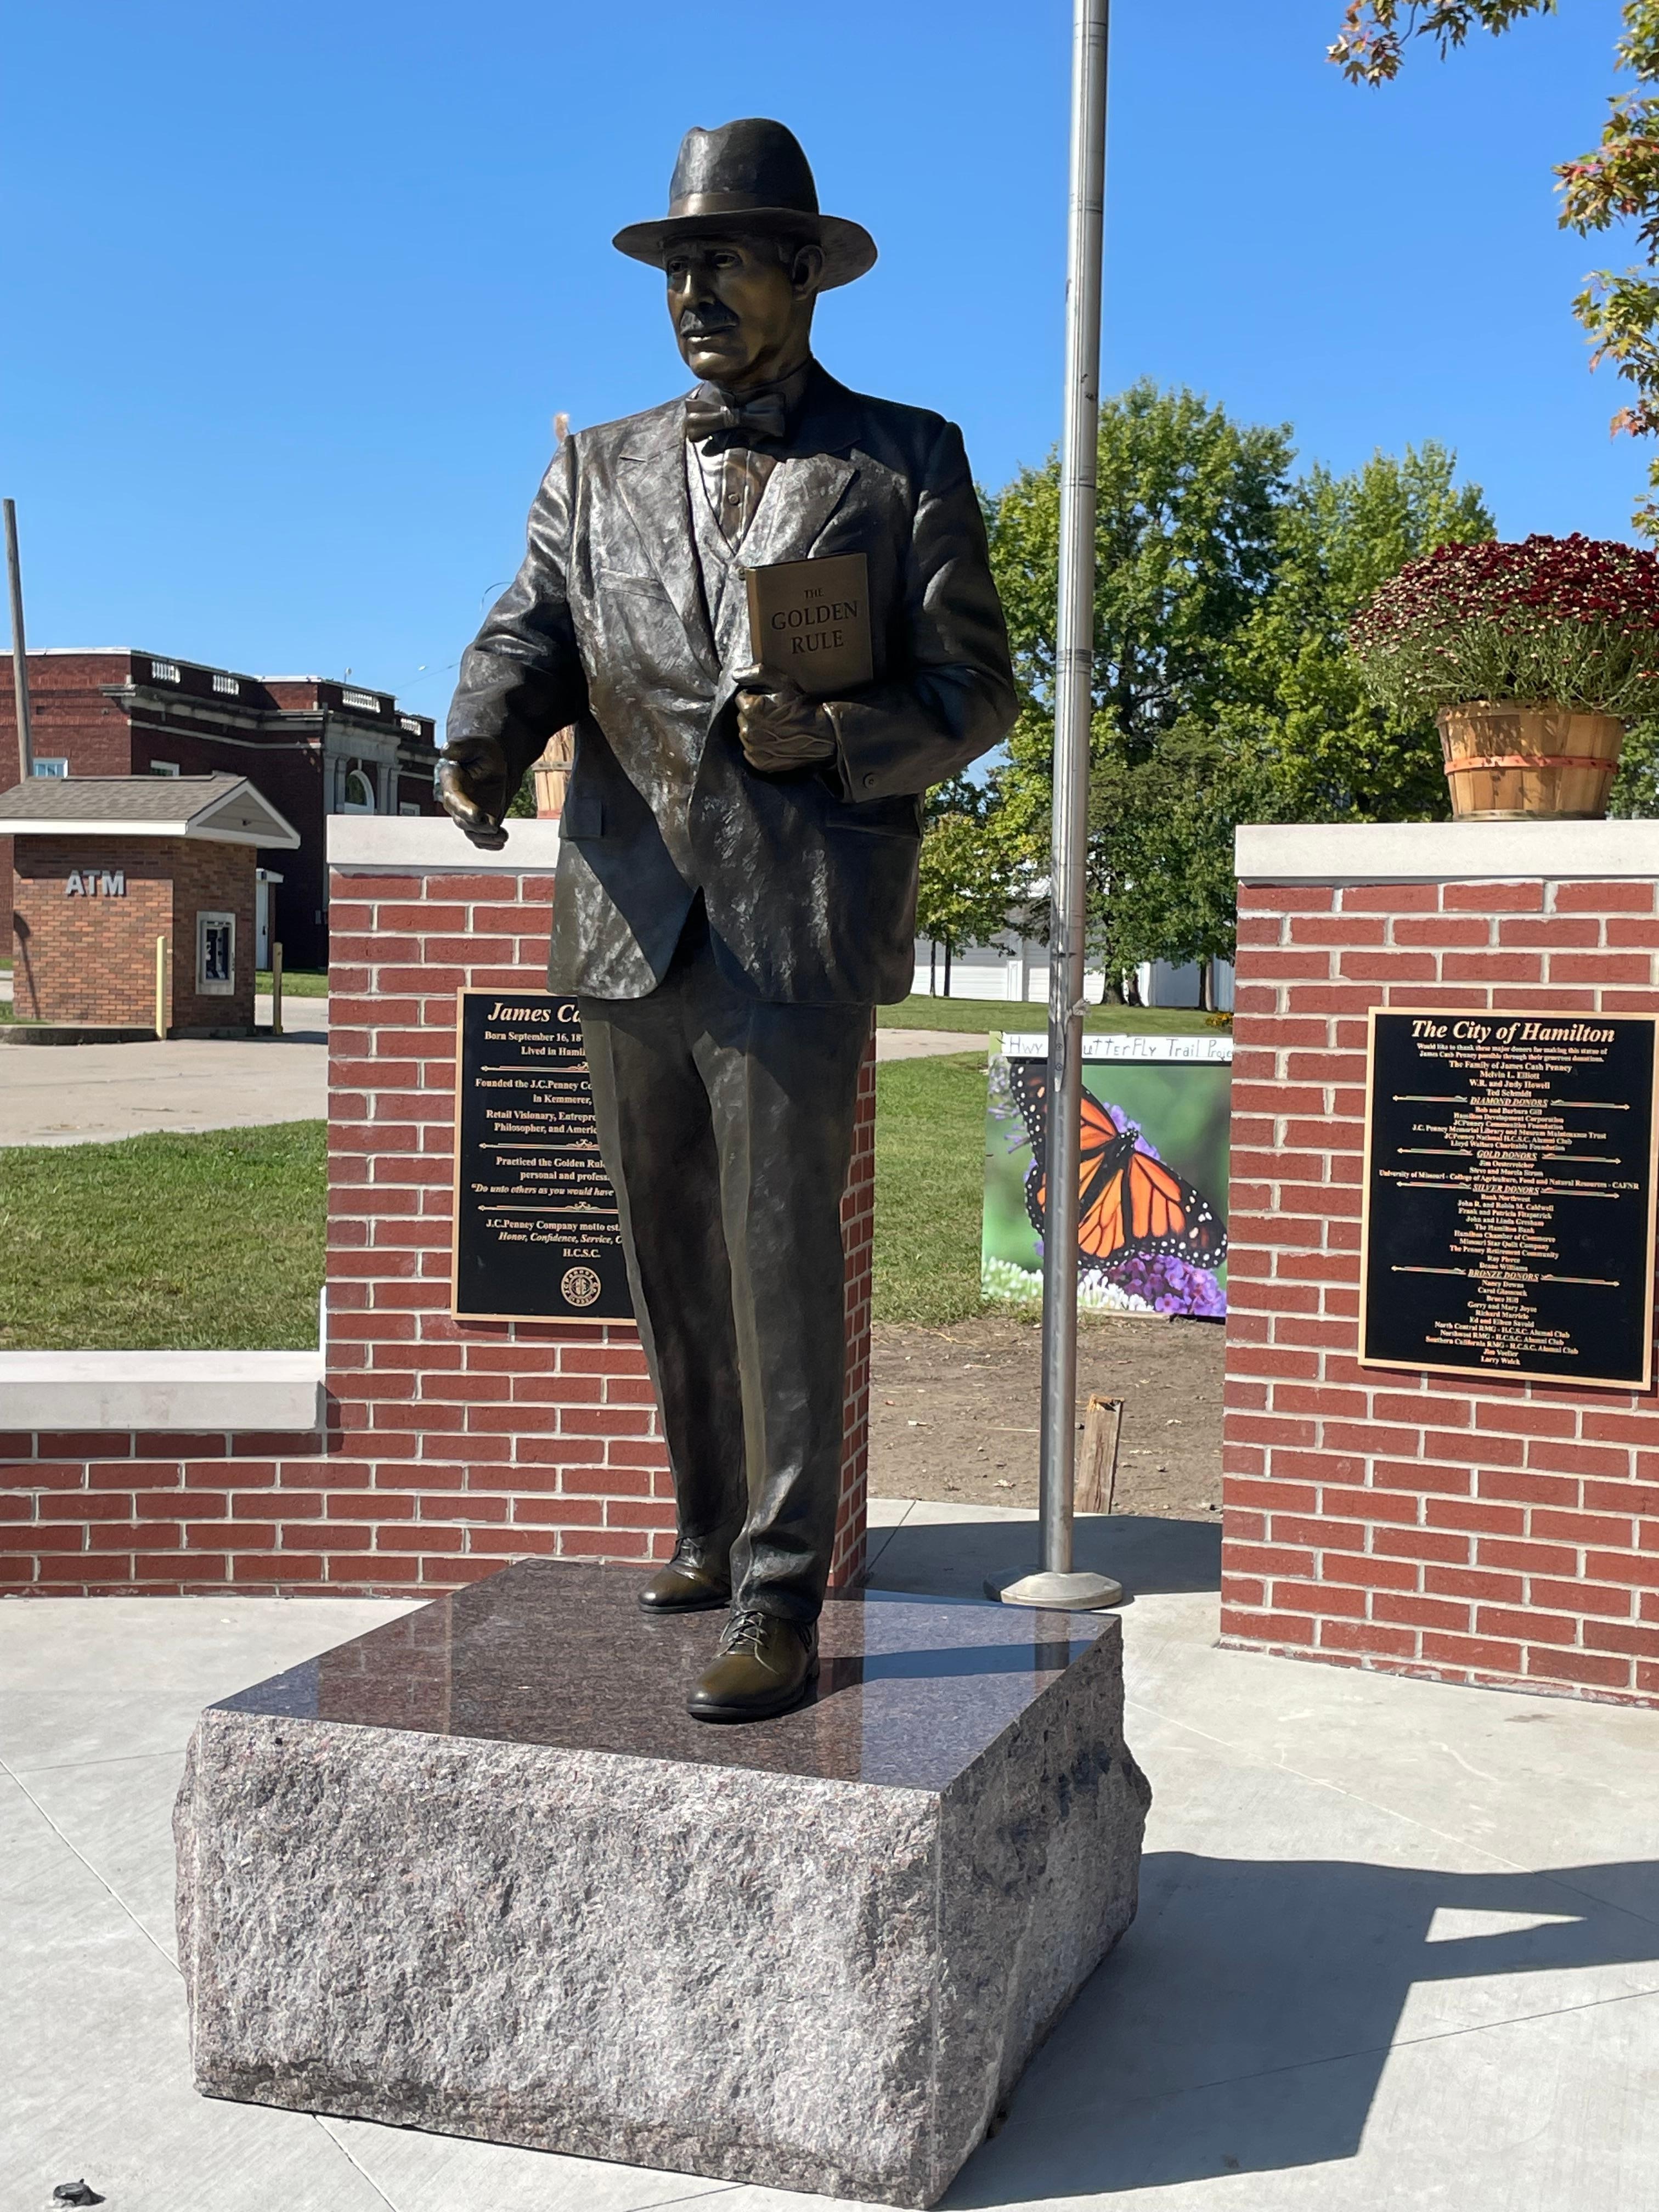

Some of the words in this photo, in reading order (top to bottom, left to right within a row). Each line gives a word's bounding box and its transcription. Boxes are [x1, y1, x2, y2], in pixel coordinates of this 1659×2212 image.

[804, 588, 825, 599] THE
[771, 600, 858, 630] GOLDEN
[791, 630, 844, 654] RULE
[65, 870, 125, 895] ATM
[487, 1002, 551, 1023] James
[485, 1031, 506, 1040] Born
[508, 1032, 555, 1043] September
[556, 1033, 569, 1043] 16,
[571, 1033, 583, 1042] 18
[1412, 1020, 1447, 1038] The
[1454, 1022, 1491, 1043] City
[1496, 1023, 1520, 1043] of
[1520, 1023, 1615, 1042] Hamilton
[521, 1046, 545, 1055] Lived
[548, 1047, 556, 1055] in
[1166, 1039, 1200, 1057] Trail
[475, 1078, 513, 1087] Founded
[515, 1079, 528, 1087] the
[533, 1094, 542, 1102] in
[544, 1094, 592, 1105] Kemmerer,
[486, 1109, 512, 1118] Retail
[514, 1110, 557, 1122] Visionary,
[494, 1122, 546, 1135] Philosopher,
[548, 1124, 565, 1133] and
[496, 1156, 536, 1166] Practiced
[538, 1158, 552, 1166] the
[554, 1158, 585, 1167] Golden
[587, 1159, 605, 1168] Rul
[520, 1172, 557, 1181] personal
[558, 1171, 575, 1180] and
[511, 1185, 537, 1194] others
[549, 1188, 565, 1197] you
[566, 1186, 592, 1195] would
[594, 1187, 613, 1196] have
[536, 1220, 578, 1232] Company
[499, 1231, 528, 1242] Honor,
[529, 1232, 578, 1244] Confidence,
[580, 1234, 613, 1245] Service,
[563, 1248, 601, 1257] H.C.S.C.
